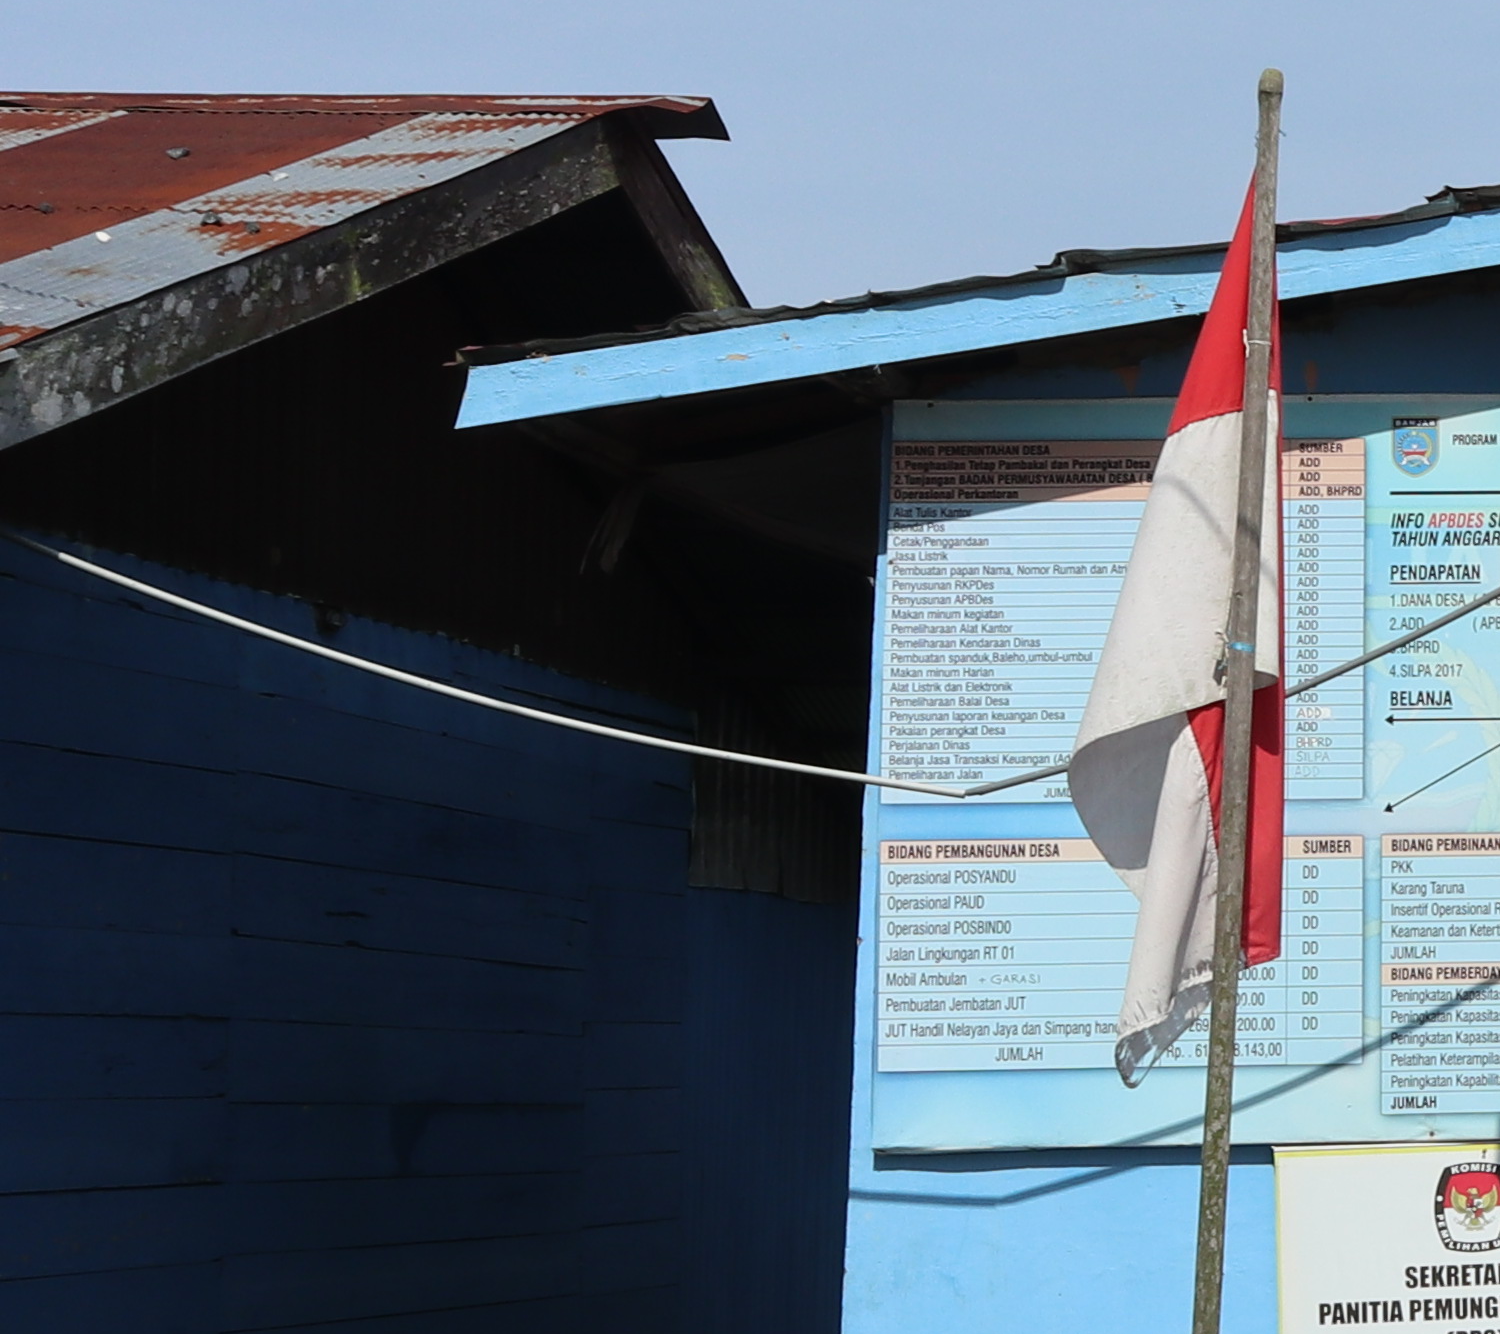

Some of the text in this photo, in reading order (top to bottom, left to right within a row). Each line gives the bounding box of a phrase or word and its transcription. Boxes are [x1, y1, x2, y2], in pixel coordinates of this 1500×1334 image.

[1452, 434, 1497, 446] PROGRAM
[1299, 443, 1343, 452] SUMBER
[1391, 513, 1424, 529] INFO
[1428, 513, 1484, 528] APBDES
[893, 536, 989, 549] Cetak/Penggandaan
[1391, 532, 1438, 547] TAHUN
[894, 551, 949, 562] Jasa Listrik
[1390, 565, 1480, 581] PENDAPATAN
[1390, 665, 1432, 679] 4.SILPA
[1436, 665, 1462, 677] 2017
[1390, 691, 1452, 707] BELANJA
[888, 844, 1060, 859] BIDANG PEMBANGUNAN DESA
[1303, 840, 1351, 853] SUMBER
[1391, 839, 1432, 852] BIDANG
[1437, 838, 1500, 851] PEMBINAAN
[955, 870, 1016, 883] POSYANDU
[990, 974, 1041, 985] GARASI
[995, 1048, 1043, 1062] JUMLAH
[1451, 1162, 1498, 1174] KOMISI
[1319, 1301, 1402, 1325] PANITIA
